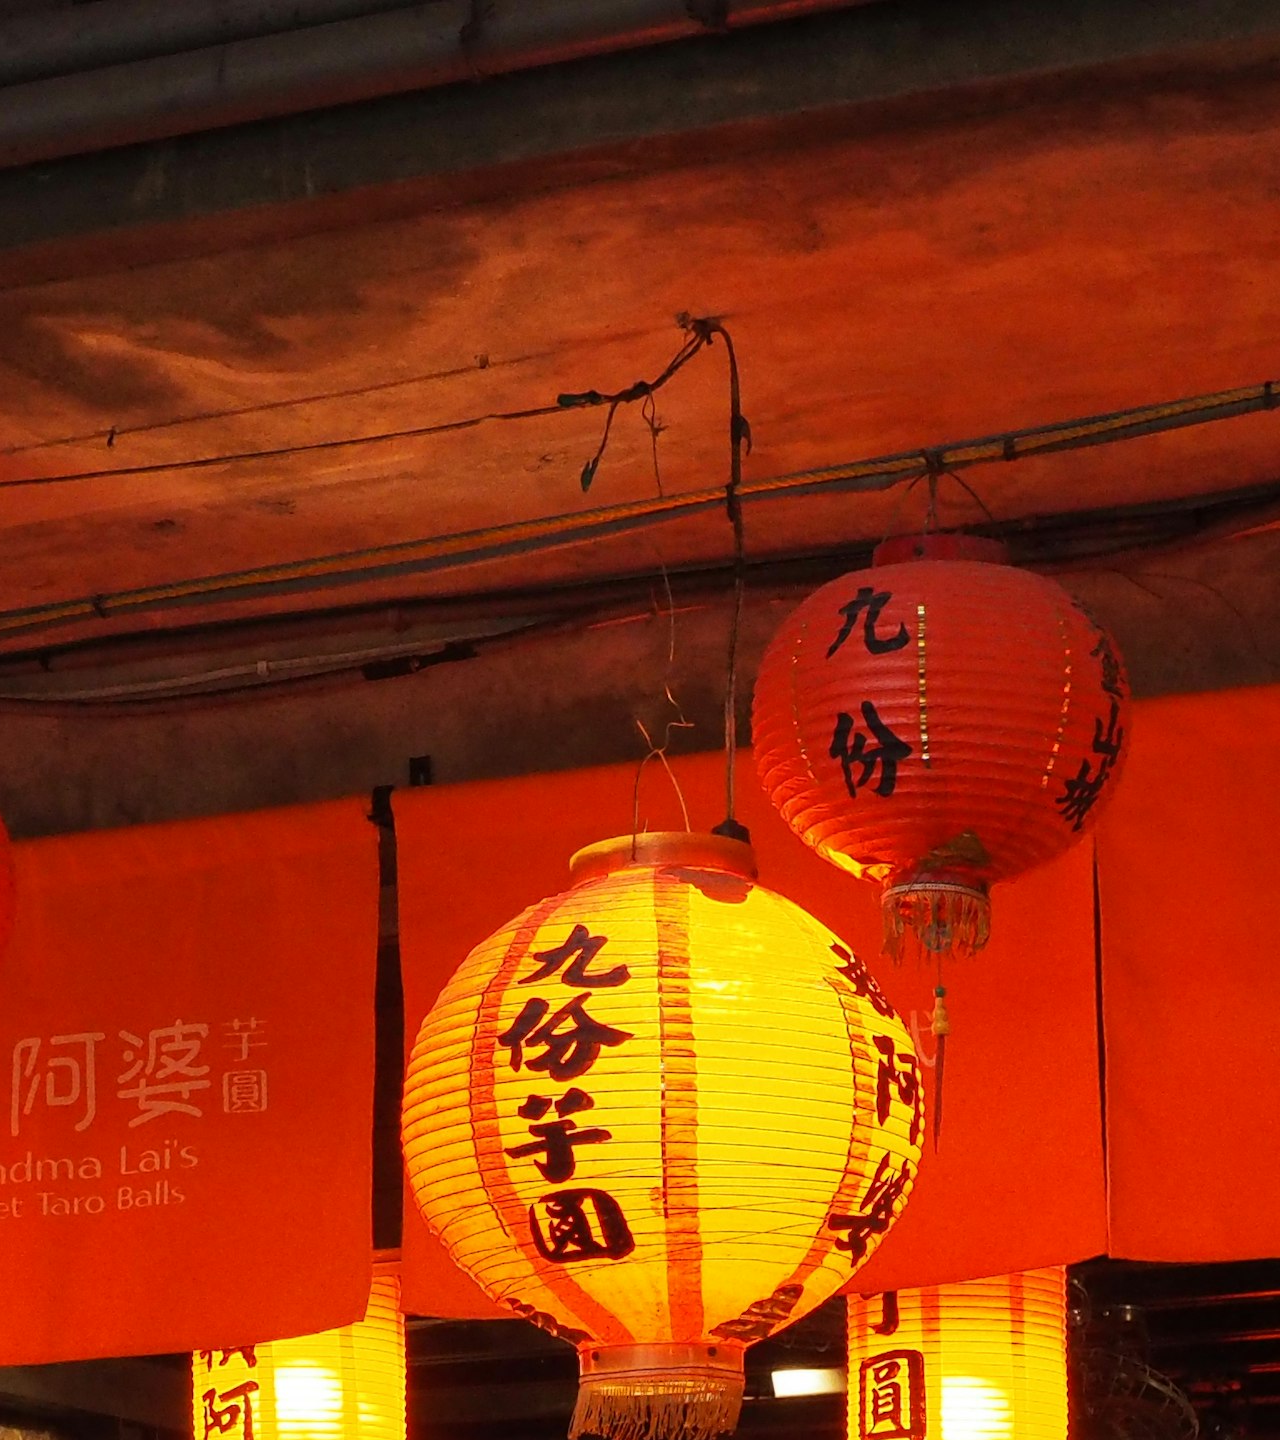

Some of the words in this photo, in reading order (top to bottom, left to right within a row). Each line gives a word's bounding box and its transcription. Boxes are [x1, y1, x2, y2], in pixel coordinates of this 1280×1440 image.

[828, 587, 913, 798] 九份
[1055, 596, 1125, 832] 金山城
[221, 1017, 268, 1114] 芋圓
[497, 923, 635, 1264] 九份芋圓
[36, 1192, 105, 1215] Taro
[117, 1180, 185, 1210] Balls
[120, 1139, 198, 1175] Lai's
